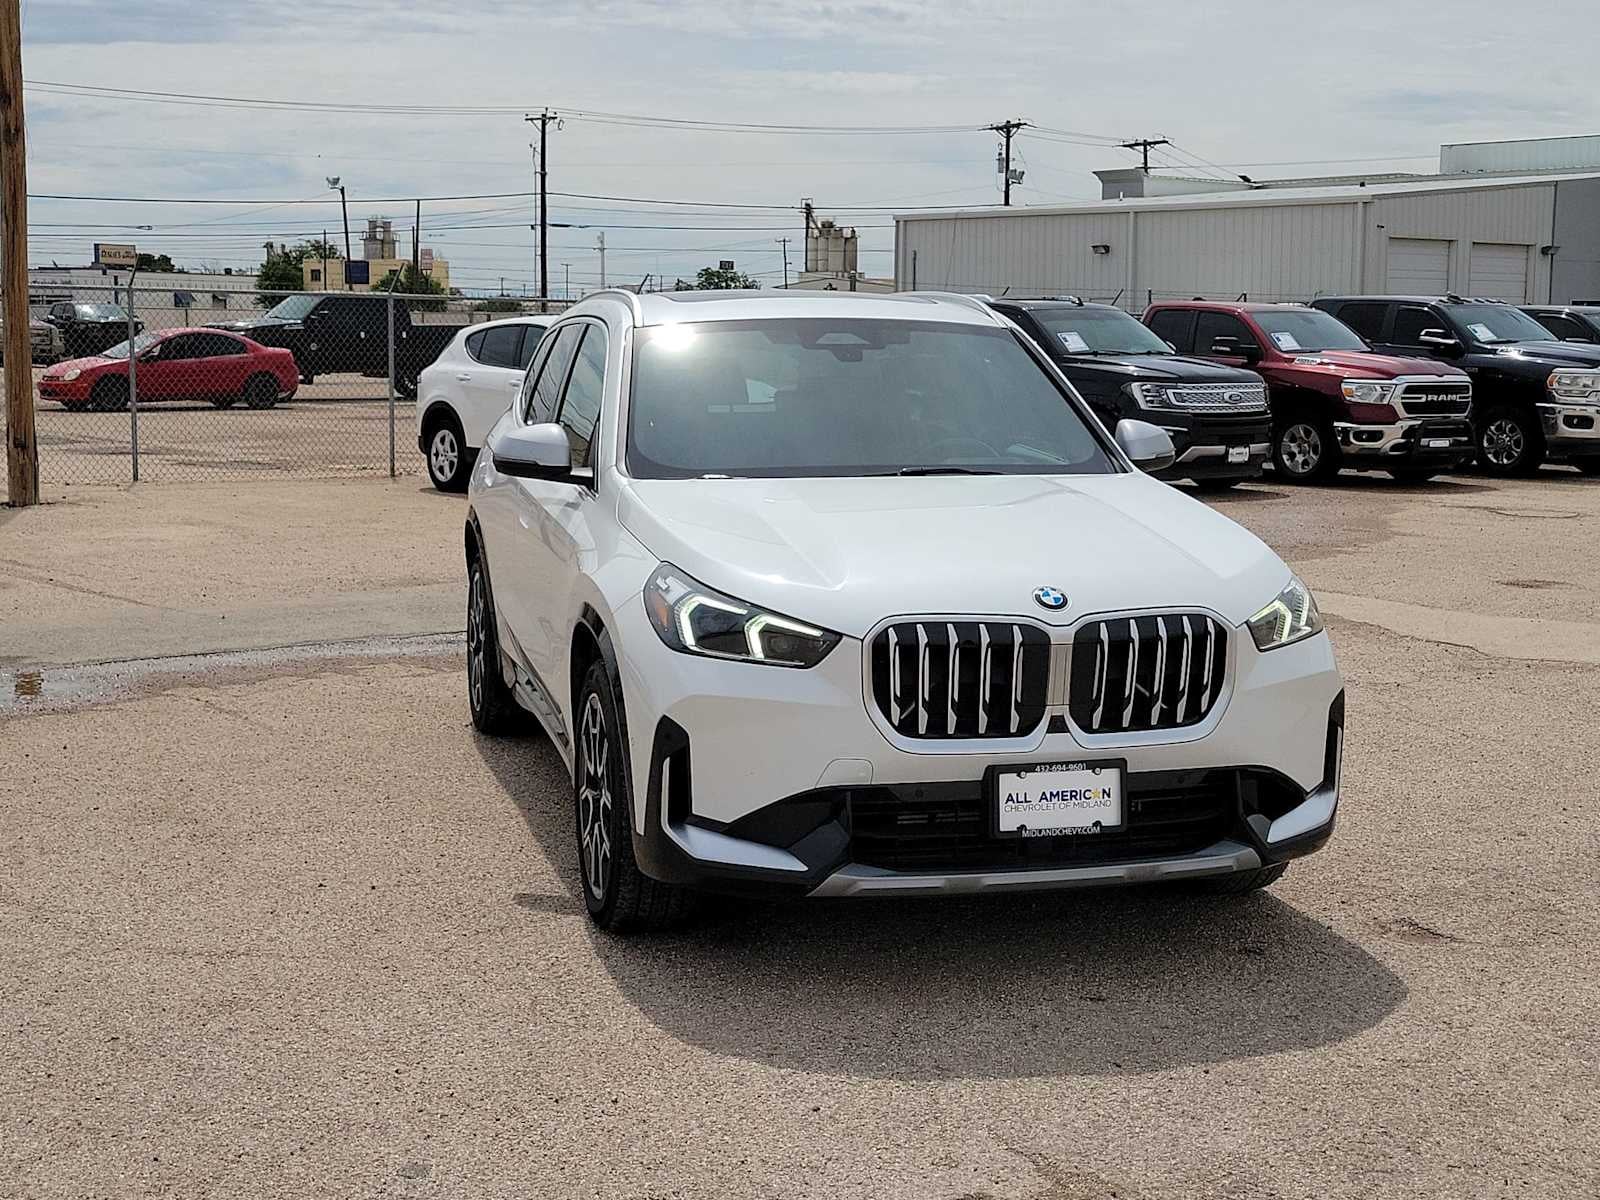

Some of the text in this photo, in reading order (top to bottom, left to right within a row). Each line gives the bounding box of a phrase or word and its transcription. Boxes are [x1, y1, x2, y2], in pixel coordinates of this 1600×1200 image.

[1035, 762, 1087, 773] 432-694-9601
[1004, 792, 1032, 804] ALL
[1004, 799, 1112, 813] CHEVROLET OF MIDLAND
[1021, 826, 1101, 838] MIDLANDCHEVY.COM
